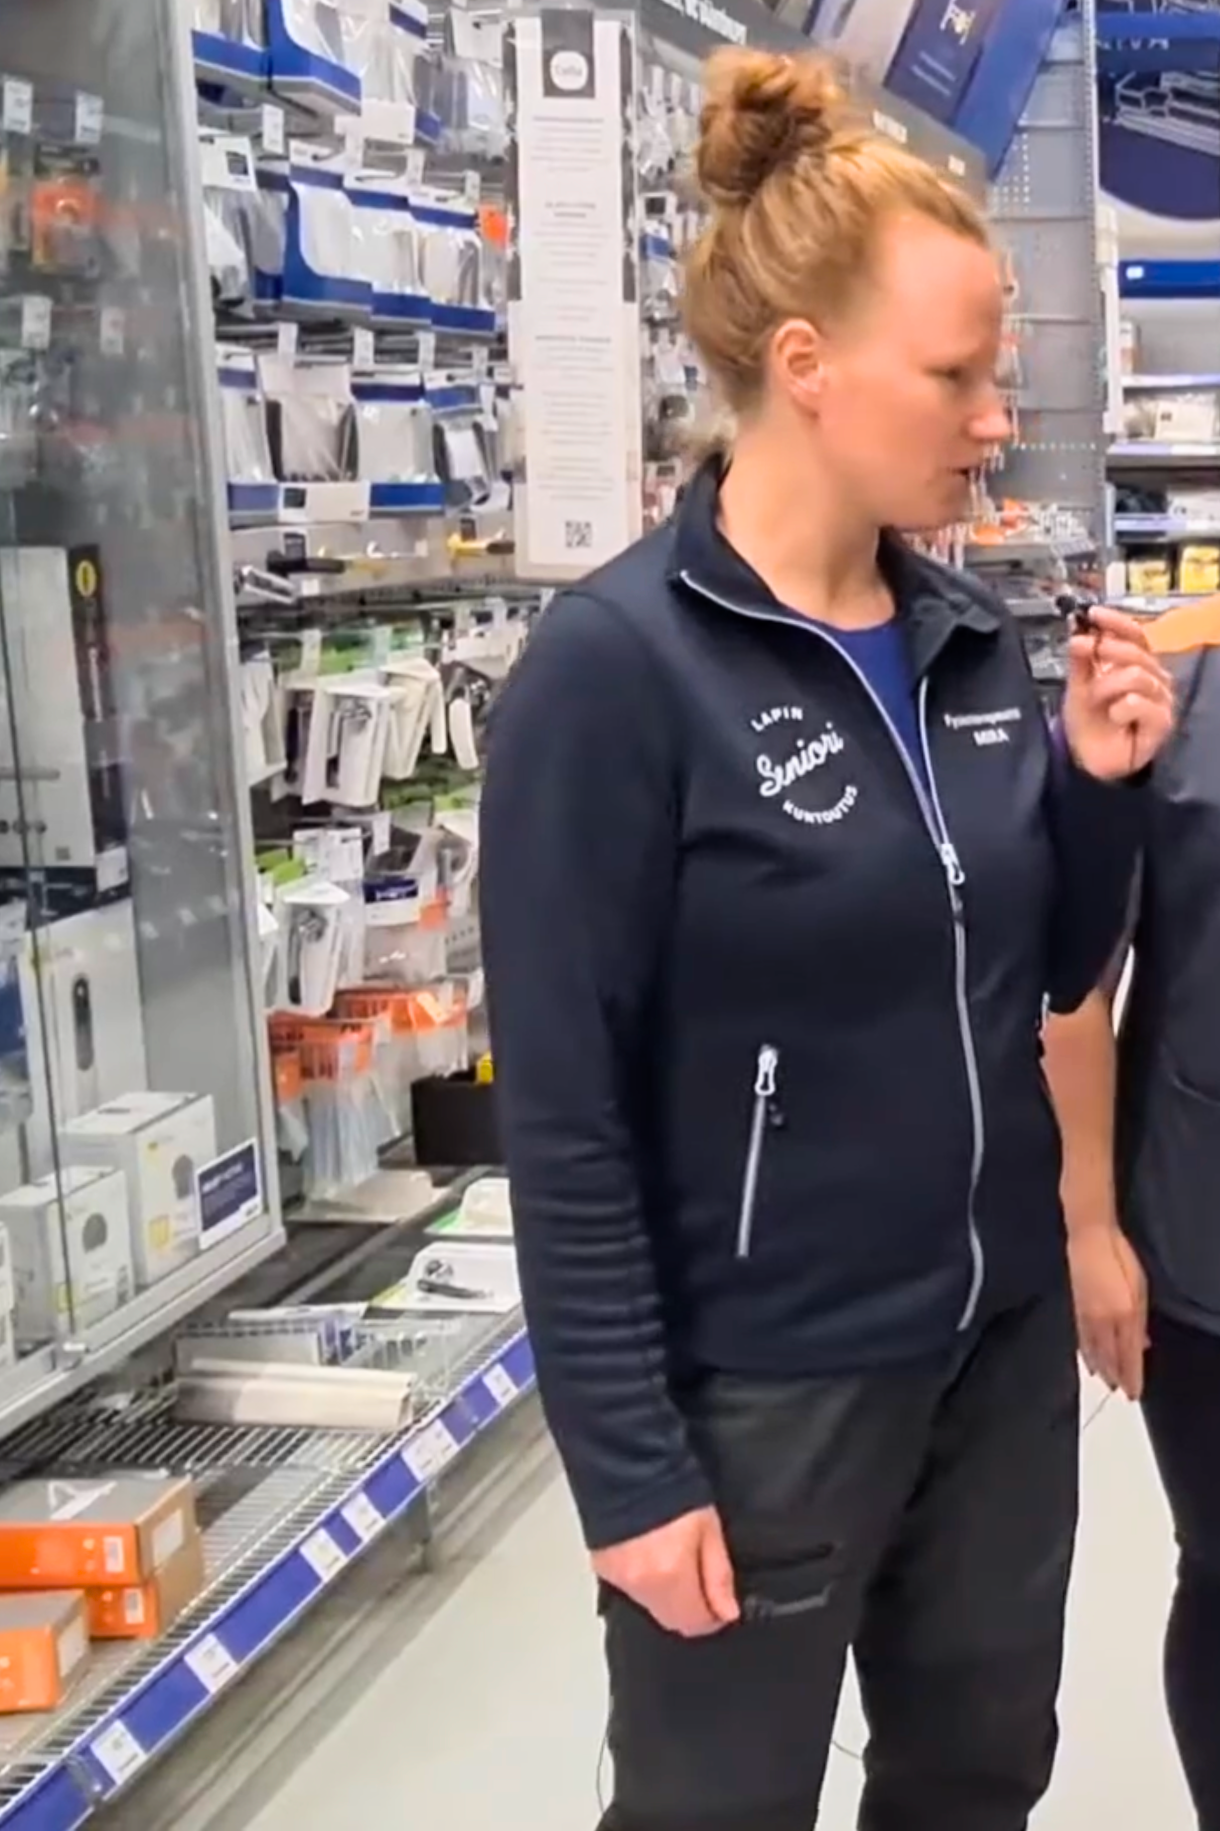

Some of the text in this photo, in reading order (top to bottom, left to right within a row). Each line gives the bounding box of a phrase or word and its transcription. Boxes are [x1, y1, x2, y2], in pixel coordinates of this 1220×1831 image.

[750, 706, 803, 732] LAPIN
[756, 721, 844, 797] Seniori
[782, 785, 858, 824] KUNTOUTUS
